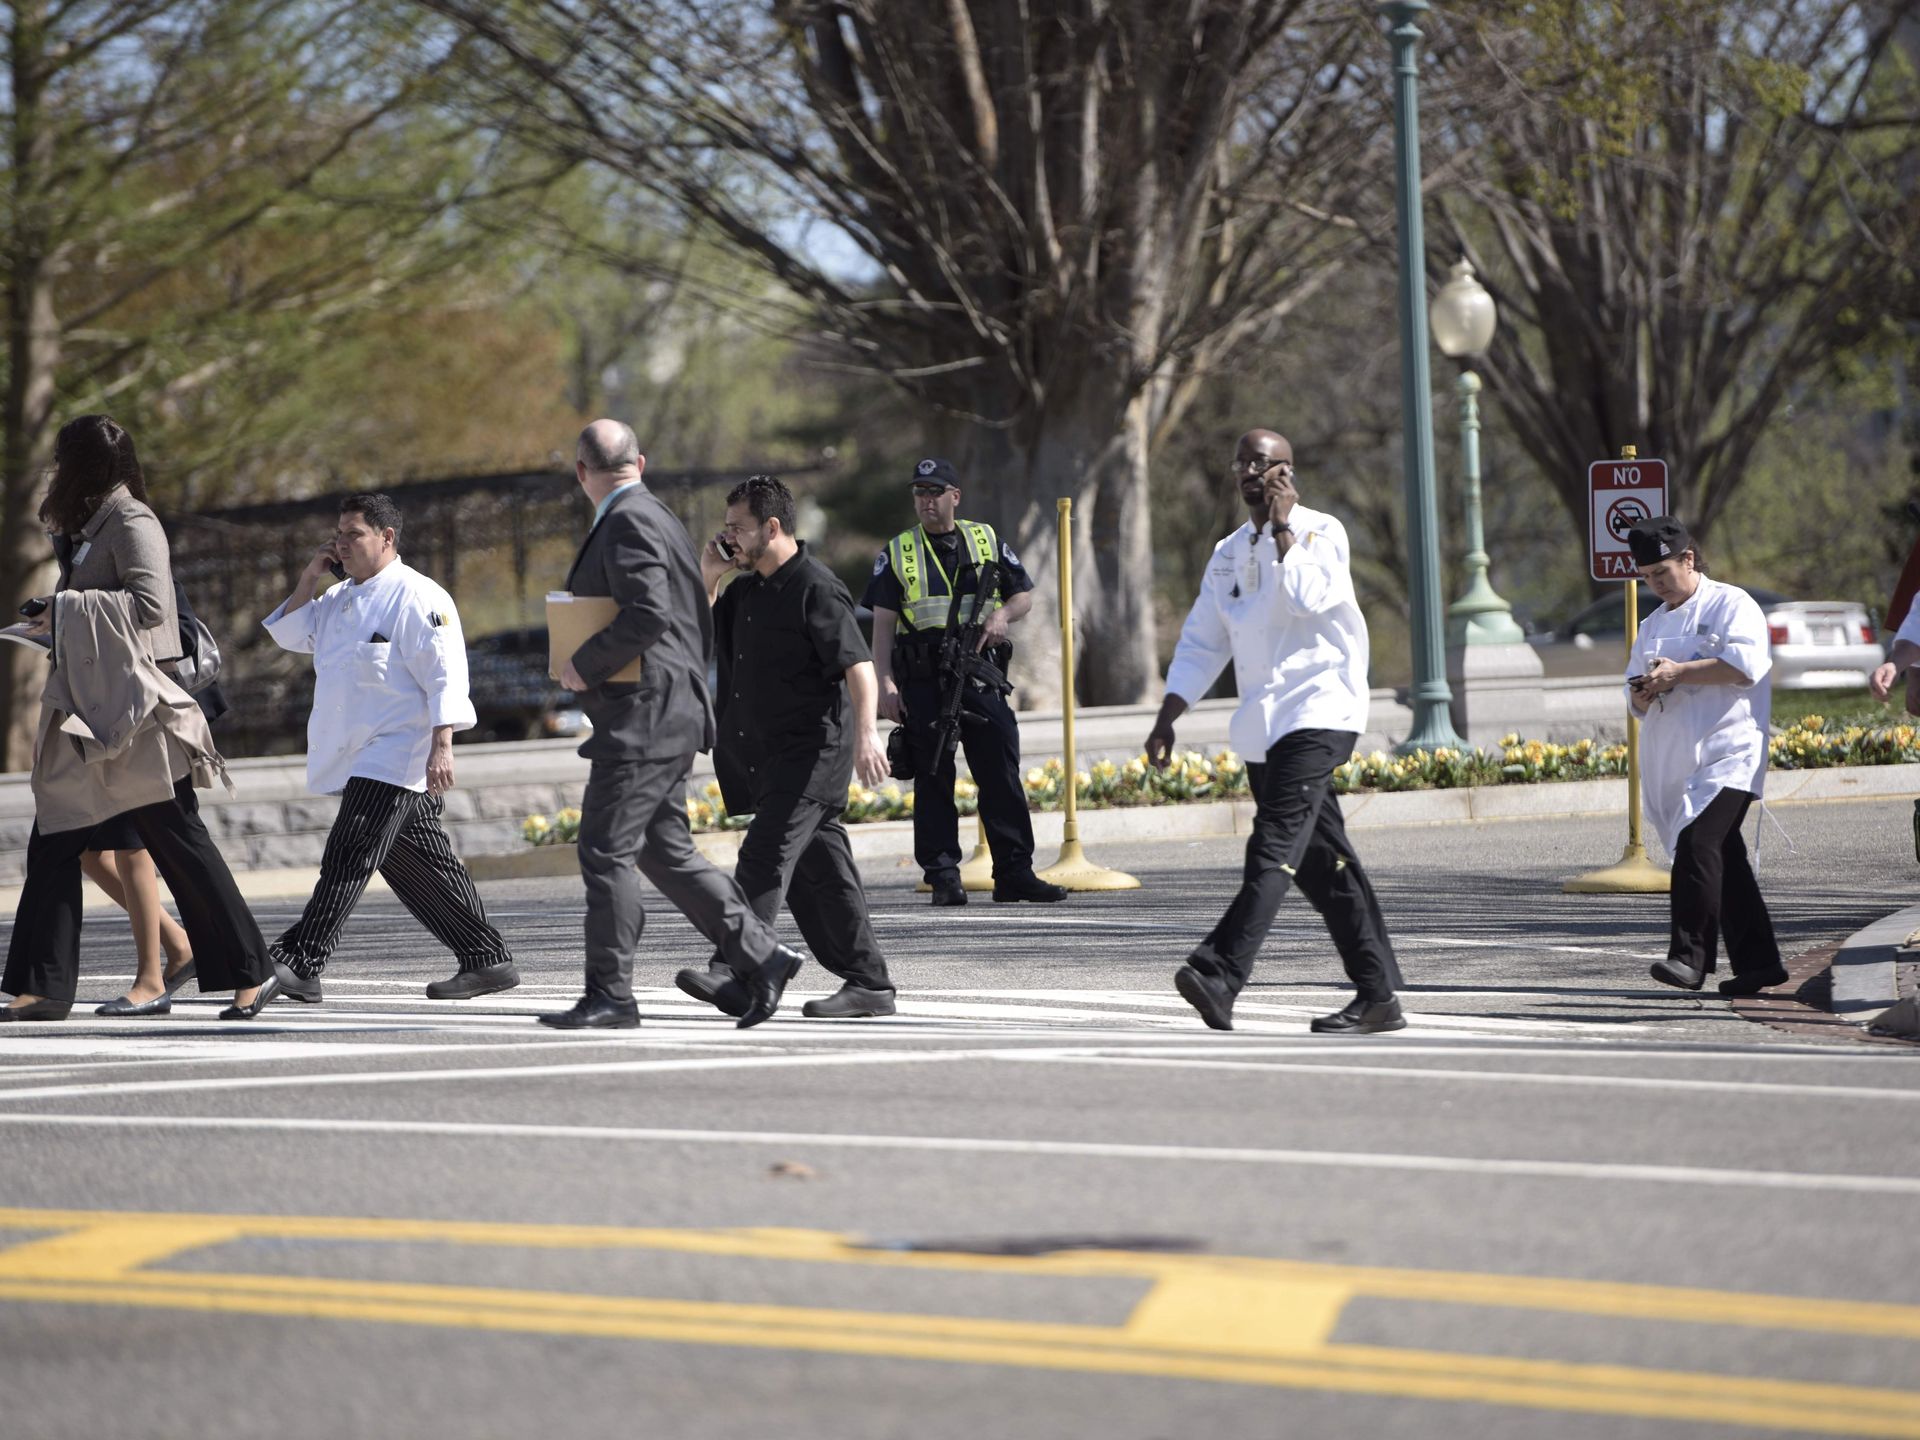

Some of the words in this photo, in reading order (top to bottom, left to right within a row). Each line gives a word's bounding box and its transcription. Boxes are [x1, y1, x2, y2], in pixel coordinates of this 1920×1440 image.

[1613, 467, 1641, 485] NO
[974, 529, 990, 557] POL
[902, 543, 916, 586] USCP
[1601, 556, 1639, 574] TAX
